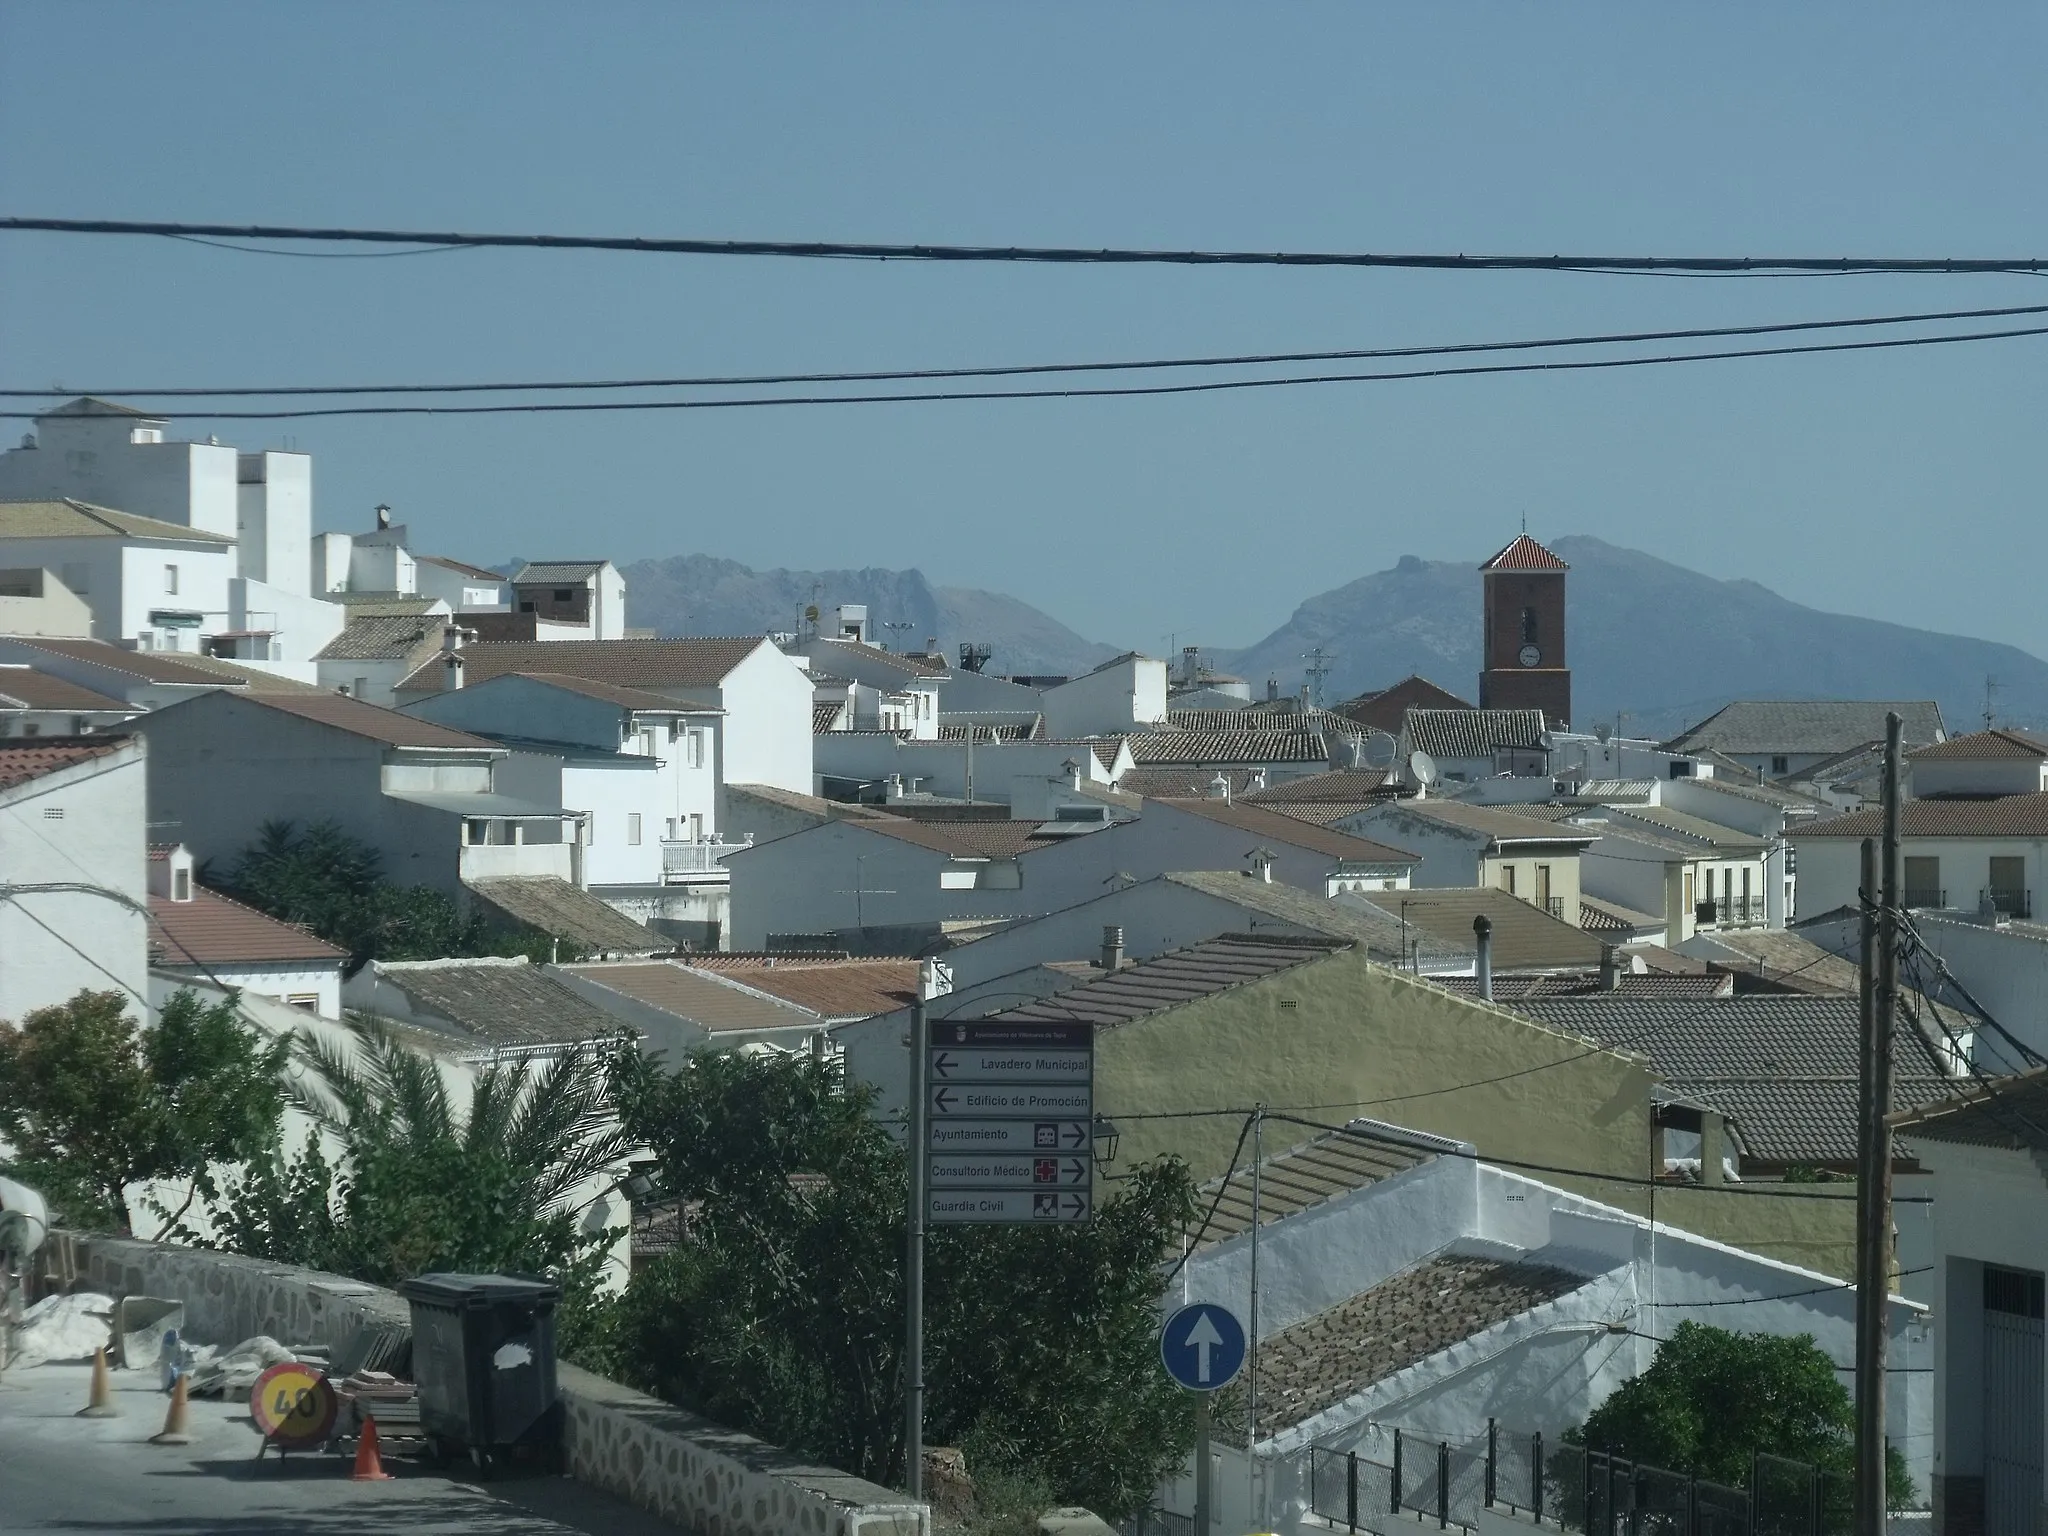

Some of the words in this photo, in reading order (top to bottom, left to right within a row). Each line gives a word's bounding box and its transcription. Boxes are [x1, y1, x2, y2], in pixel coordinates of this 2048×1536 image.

[981, 1058, 1031, 1070] Lavadero
[1035, 1058, 1088, 1073] Municipal
[967, 1095, 1008, 1106] Edificio
[1012, 1095, 1024, 1106] de
[1029, 1095, 1088, 1107] Promoción
[932, 1129, 1008, 1143] Ayuntamiento
[932, 1165, 990, 1177] Consultorio
[993, 1165, 1030, 1177] Médico
[932, 1200, 976, 1212] Guardia
[979, 1200, 1004, 1212] Civil
[274, 1387, 316, 1418] 40
